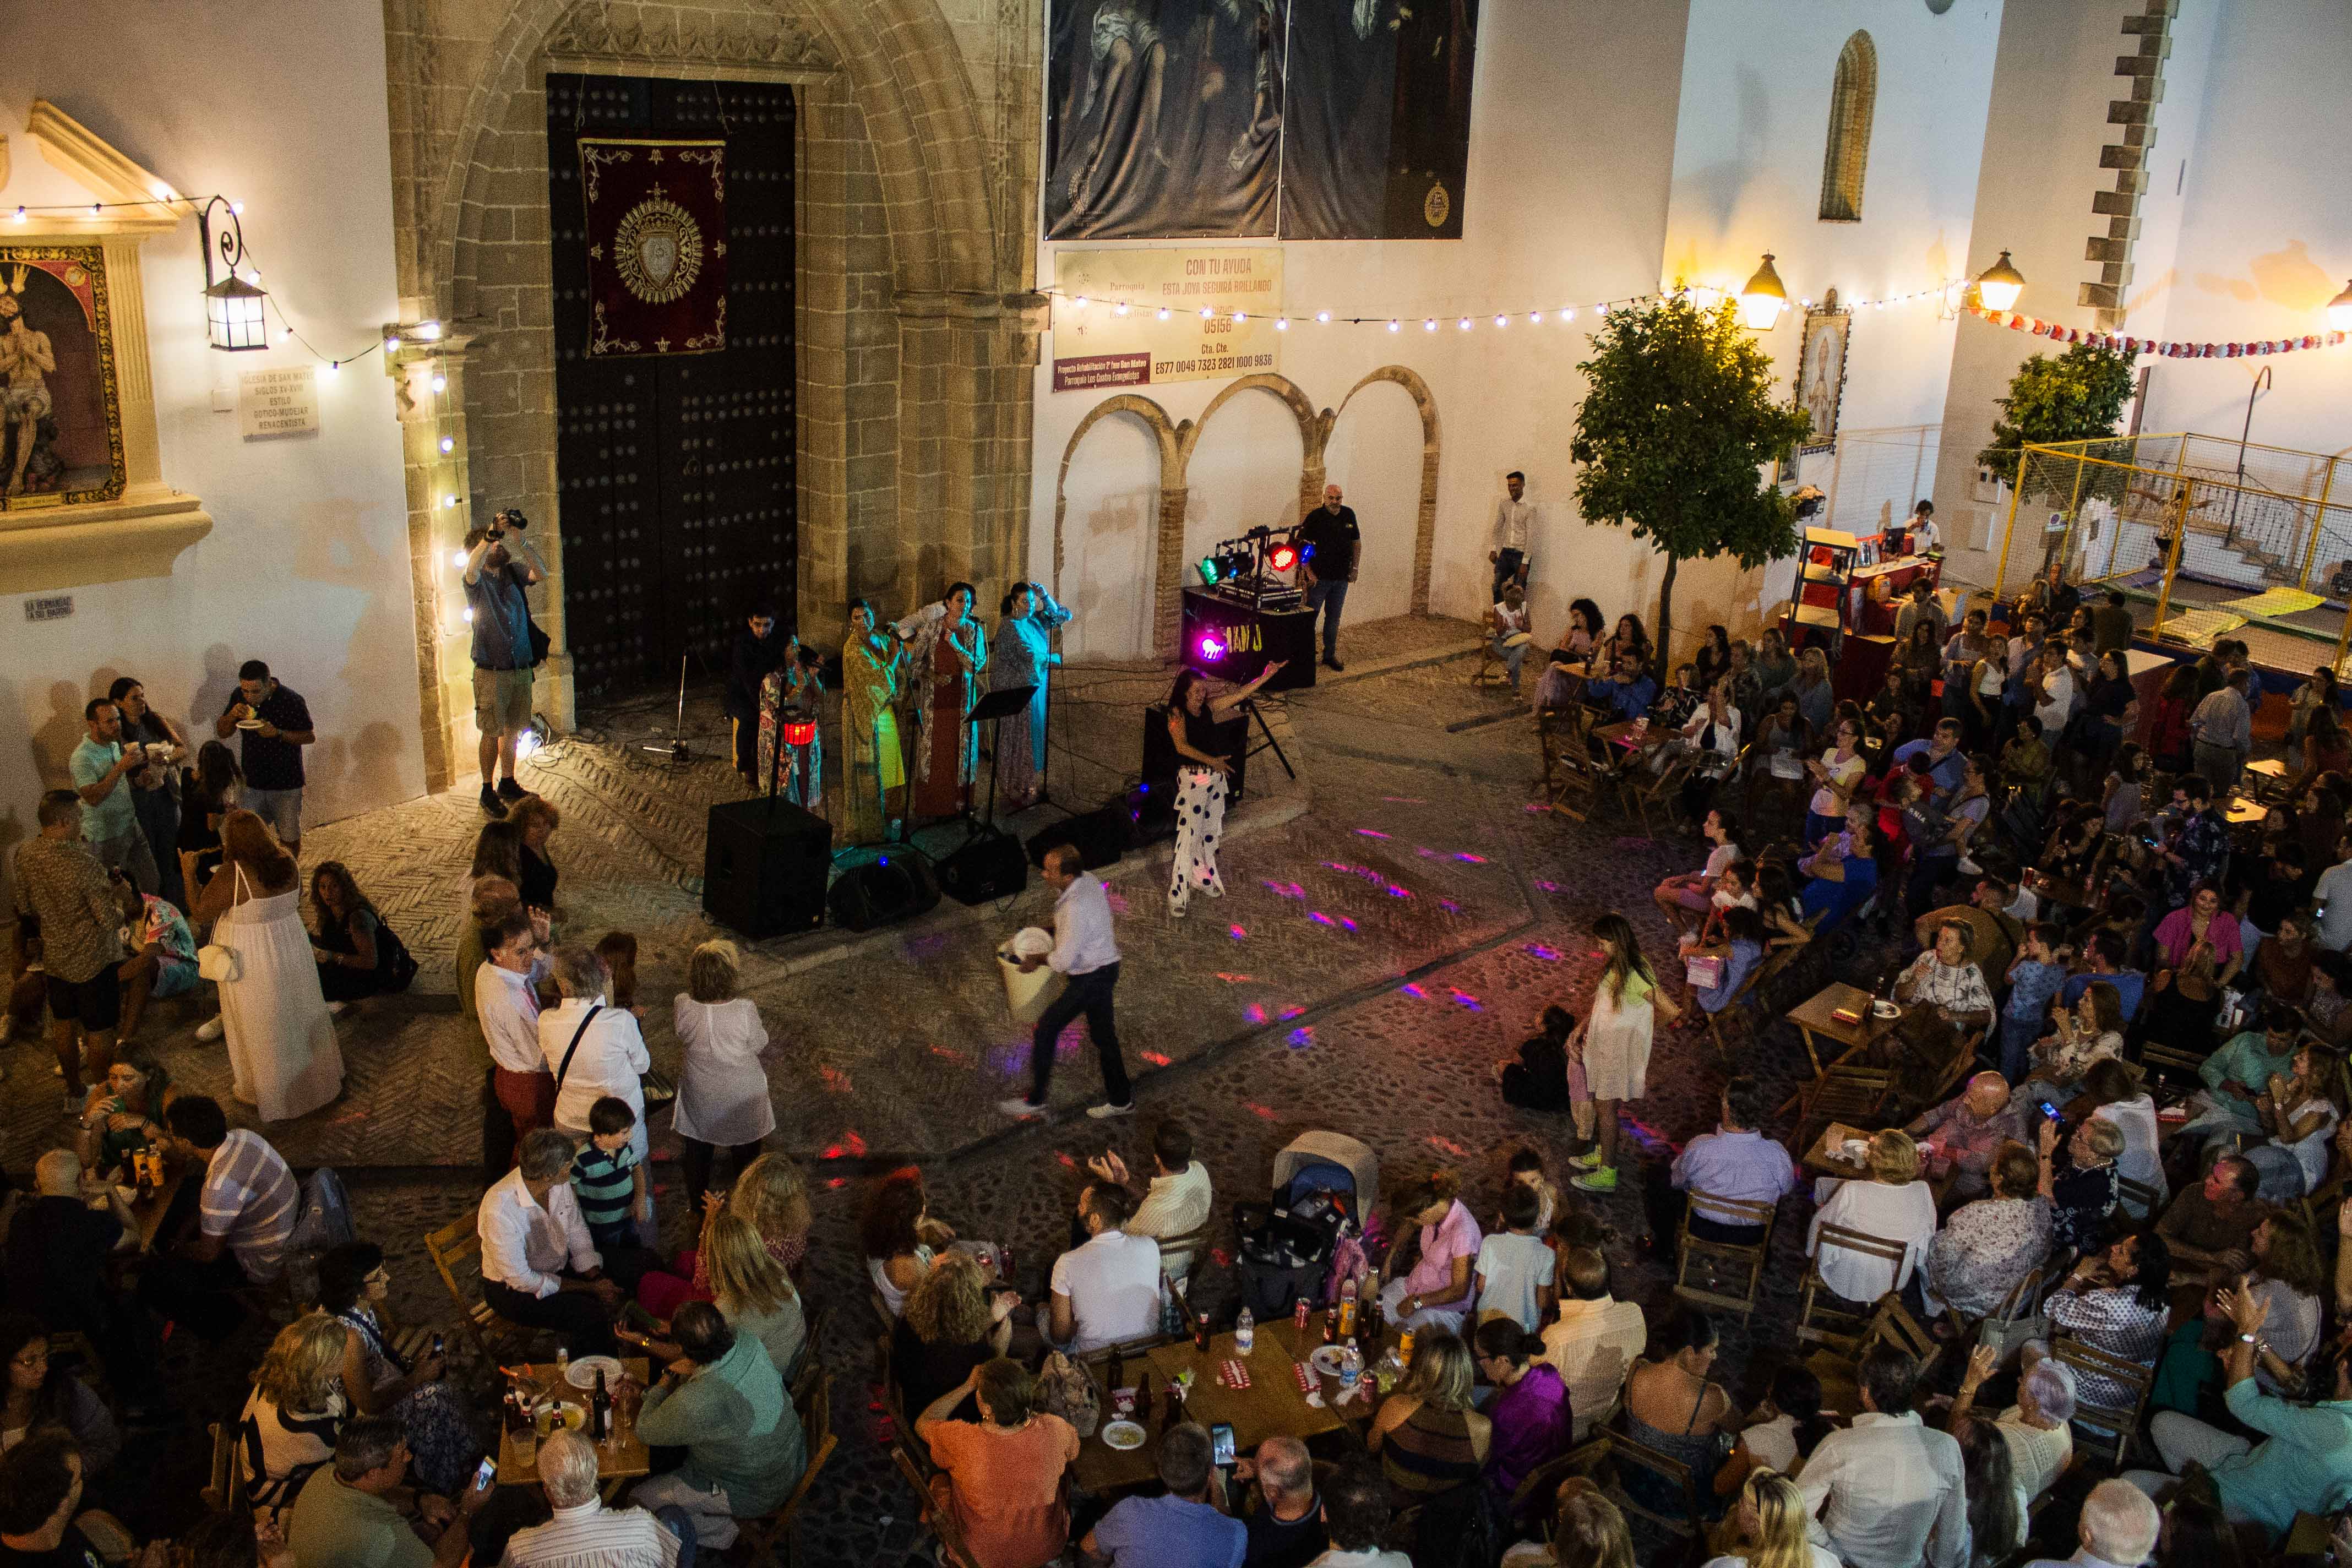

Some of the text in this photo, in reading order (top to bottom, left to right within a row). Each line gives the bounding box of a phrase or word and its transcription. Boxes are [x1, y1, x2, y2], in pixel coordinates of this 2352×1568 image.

[1186, 258, 1251, 275] CON TU AYUDA
[1110, 282, 1145, 292] Parroquia
[1163, 282, 1180, 295] ESTA
[1183, 282, 1200, 295] JOYA
[1234, 280, 1272, 292] BRILLANDO
[1205, 318, 1231, 334] 05156
[1202, 343, 1228, 354] Cta. Cte.
[1156, 355, 1272, 374] ES77 0049 7323 2821 1000 9836
[268, 374, 276, 383] DE
[269, 396, 291, 406] ESTILO
